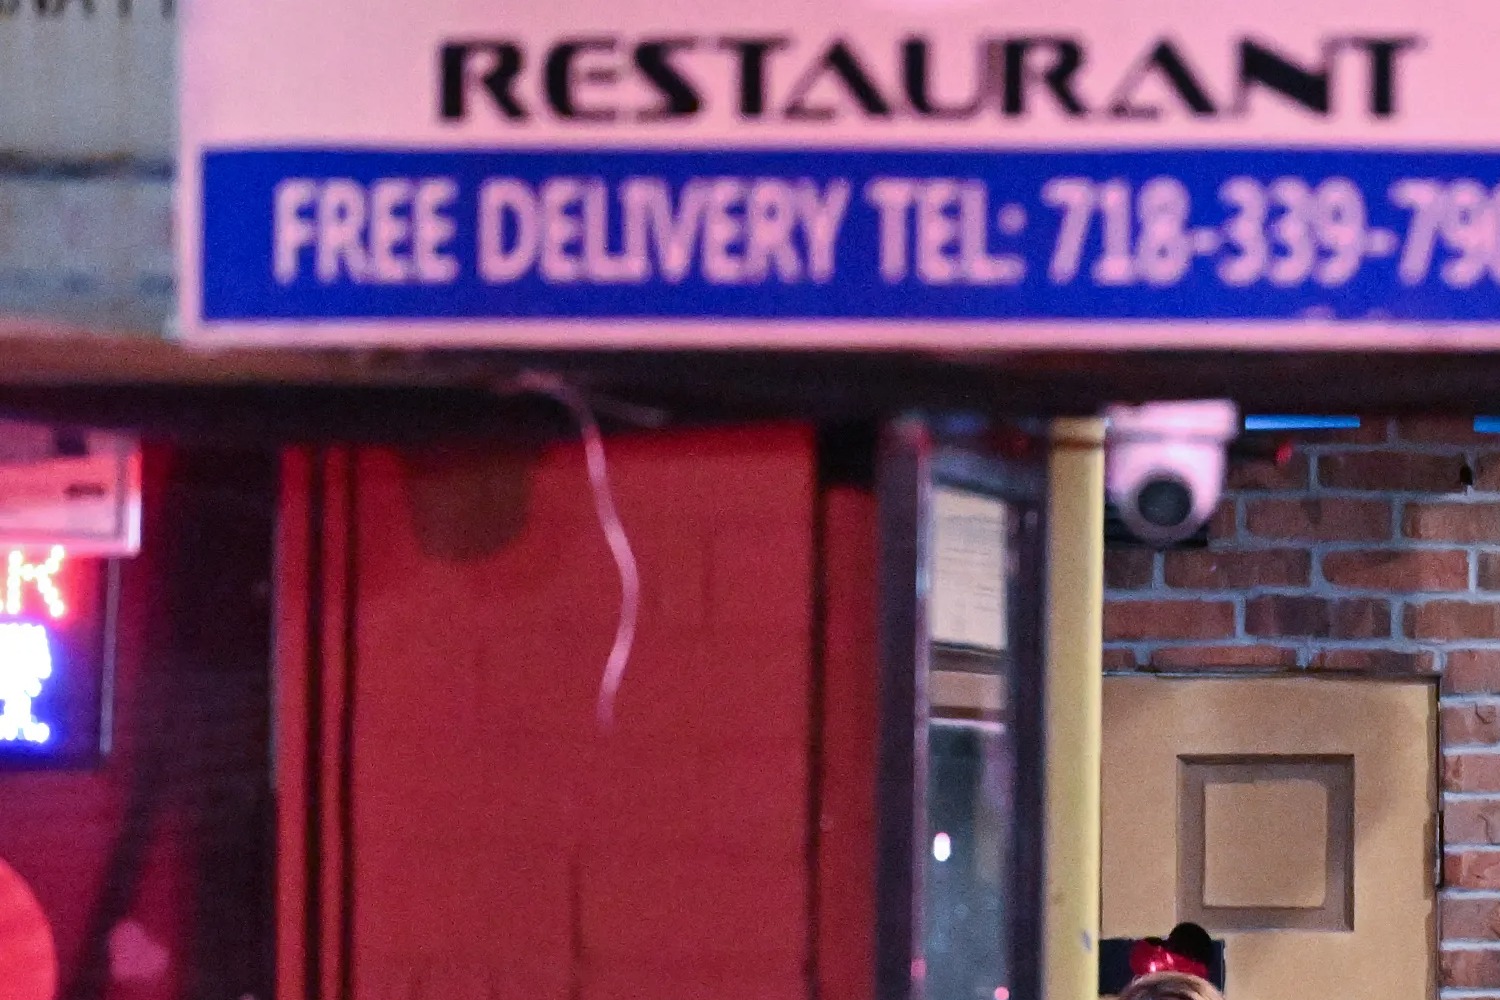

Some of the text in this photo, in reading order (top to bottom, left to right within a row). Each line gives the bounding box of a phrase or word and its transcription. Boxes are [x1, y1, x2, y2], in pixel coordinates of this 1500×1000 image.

[436, 35, 1420, 122] RESTAURANT
[273, 177, 458, 284] FREE
[478, 177, 850, 284] DELIVERY
[866, 177, 1026, 285] TEL:
